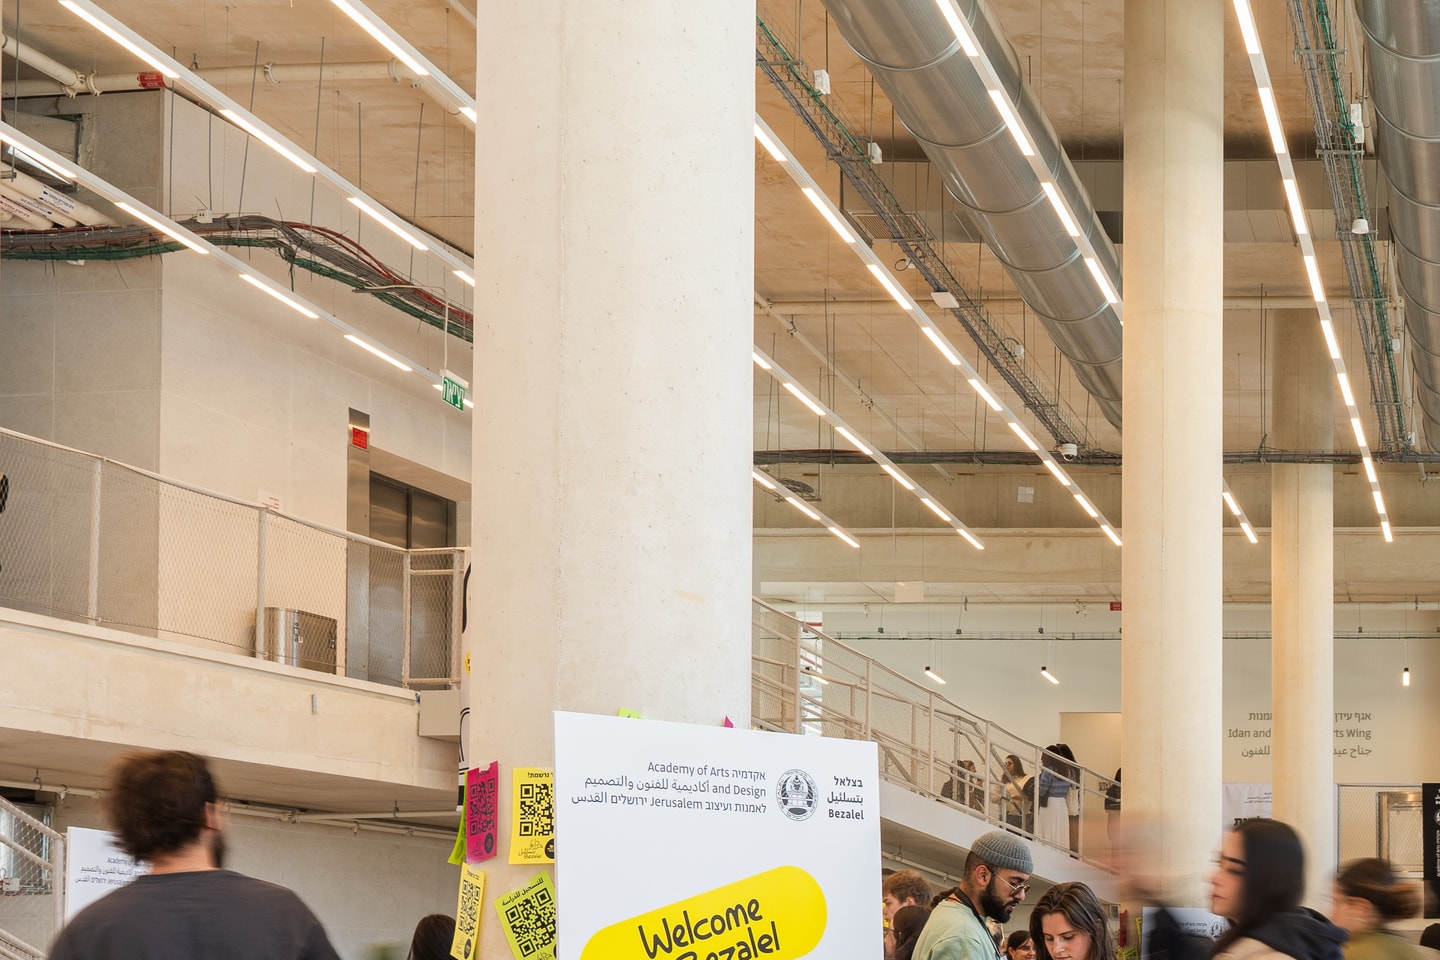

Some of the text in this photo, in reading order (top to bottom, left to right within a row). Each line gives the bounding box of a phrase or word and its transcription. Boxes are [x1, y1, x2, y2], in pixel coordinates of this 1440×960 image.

[1335, 712, 1371, 722] אגף עידן
[1228, 728, 1271, 738] Idan and
[1333, 729, 1371, 740] ts Wing
[1241, 745, 1270, 757] للفنون
[1350, 745, 1372, 758] جناح
[648, 762, 729, 777] Academy of Arts
[732, 769, 765, 782] אקדמיה
[585, 777, 709, 794] أكاديمية للفنون والتصميم
[833, 776, 863, 788] בצלאל
[712, 783, 766, 798] and Design
[827, 789, 864, 805] بتسلئيل
[571, 792, 607, 805] القدس
[611, 794, 647, 806] ירושלים
[650, 796, 702, 810] Jerusalem
[705, 800, 767, 814] לאמנות ועיצוב
[828, 808, 864, 820] Bezalel
[638, 898, 763, 960] Welcome
